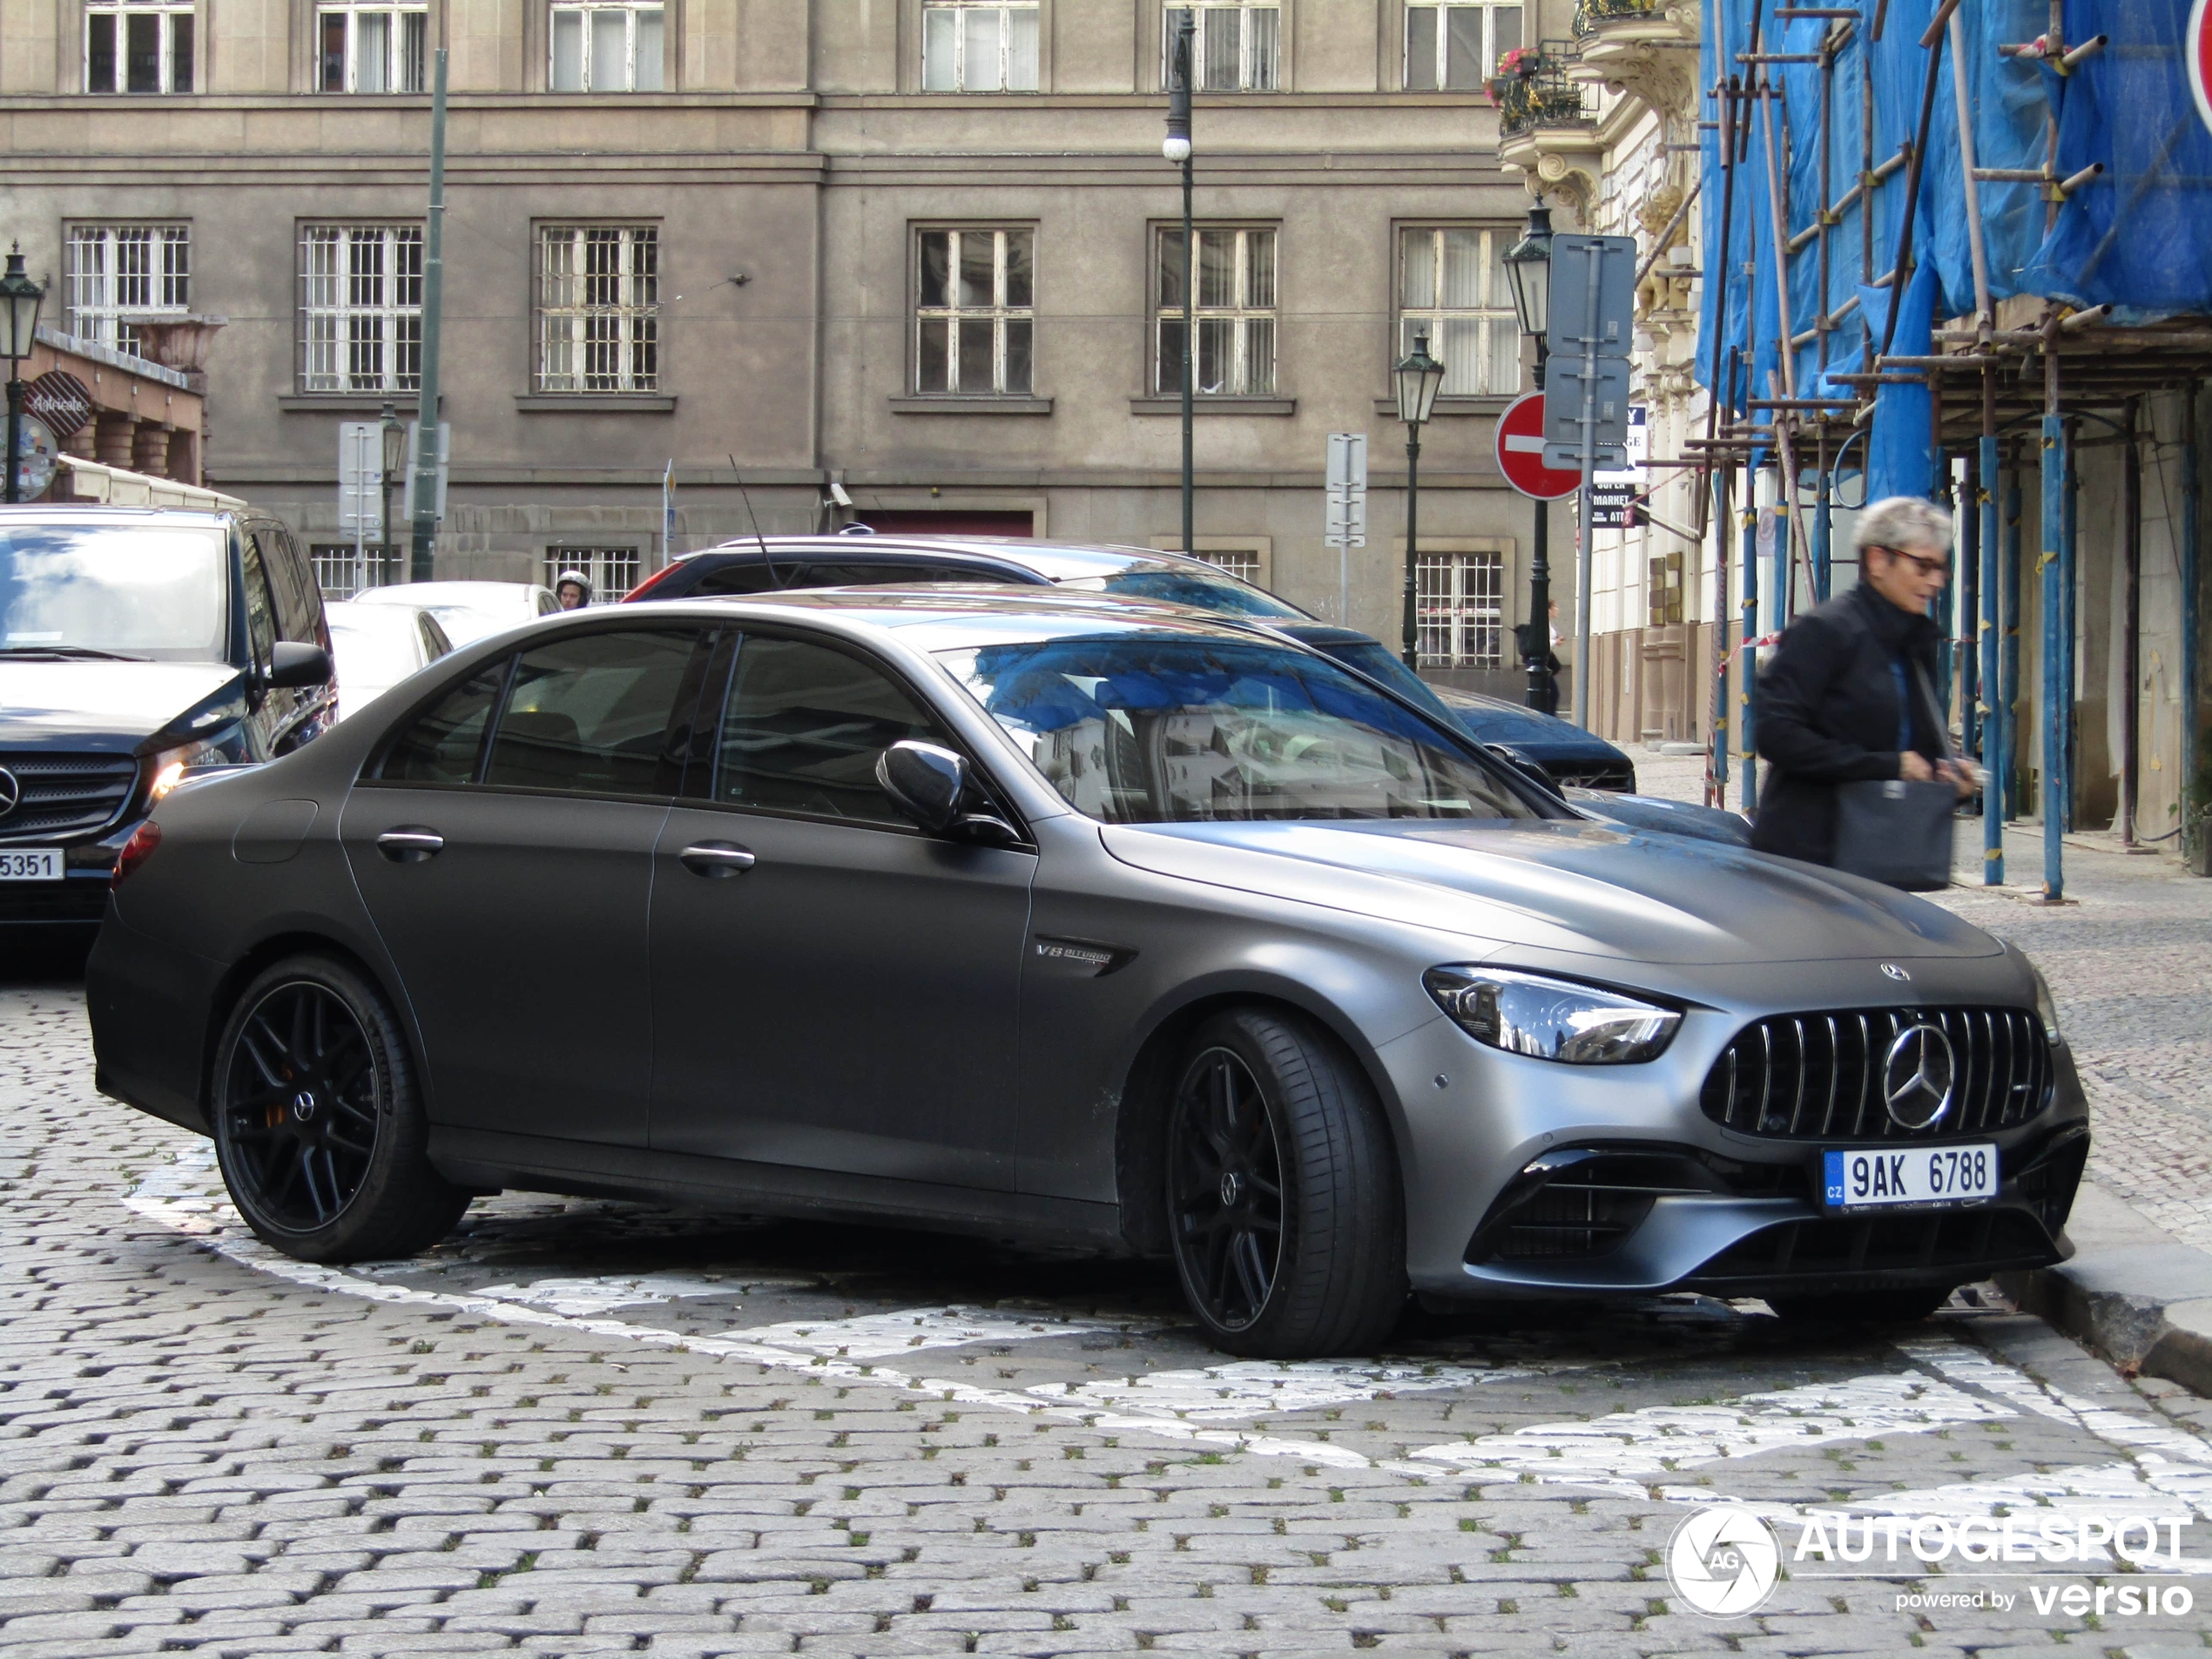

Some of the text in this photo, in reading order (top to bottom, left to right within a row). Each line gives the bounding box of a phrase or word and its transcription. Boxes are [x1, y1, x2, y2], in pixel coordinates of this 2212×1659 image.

[1594, 495, 1629, 506] MARKET
[0, 854, 52, 876] 5351
[1036, 944, 1111, 961] V8 BITURBO
[1852, 1150, 1986, 1197] 9AK 6788
[1827, 1186, 1843, 1198] CZ
